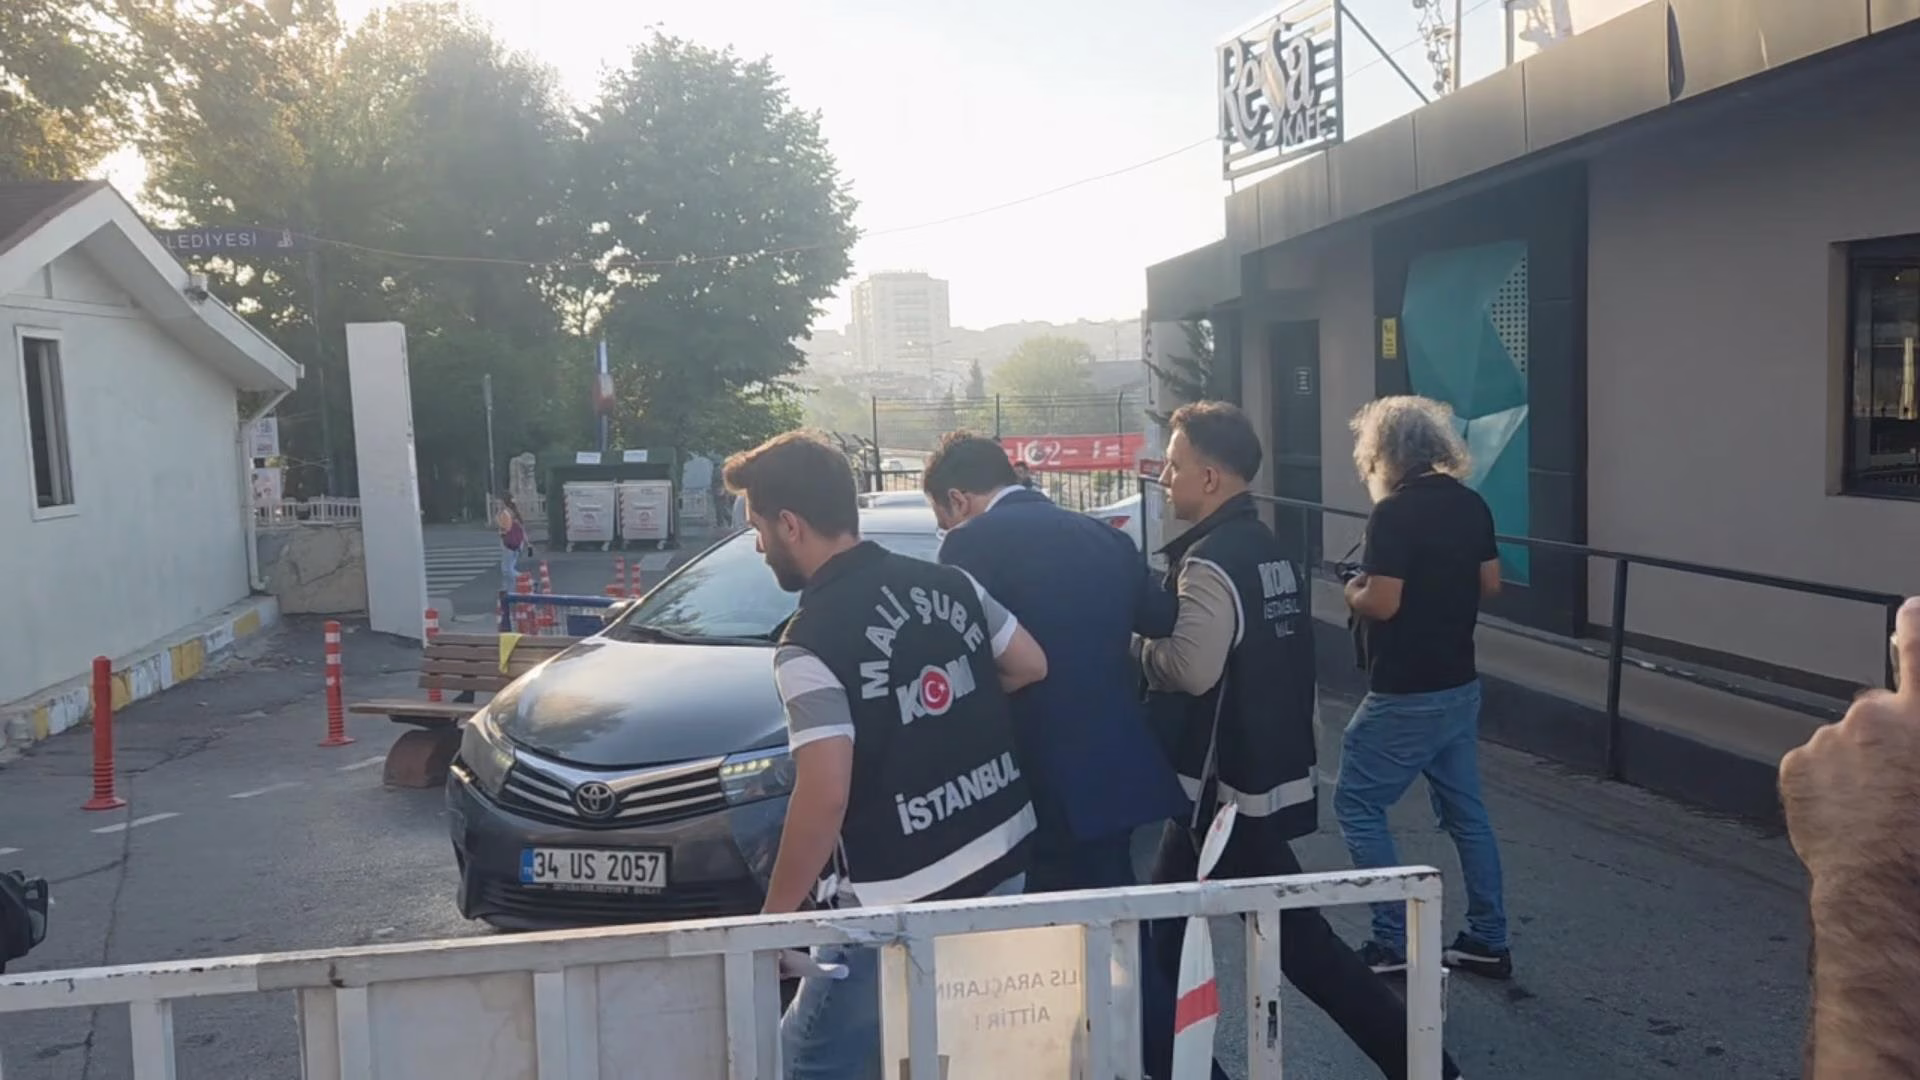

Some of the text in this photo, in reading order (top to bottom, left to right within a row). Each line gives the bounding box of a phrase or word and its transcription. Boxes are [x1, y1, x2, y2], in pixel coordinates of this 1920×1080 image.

[1282, 104, 1327, 146] KAFE
[909, 586, 984, 652] ŞUBE
[895, 752, 1020, 835] İSTANBUL
[534, 852, 660, 883] 34 US 2057
